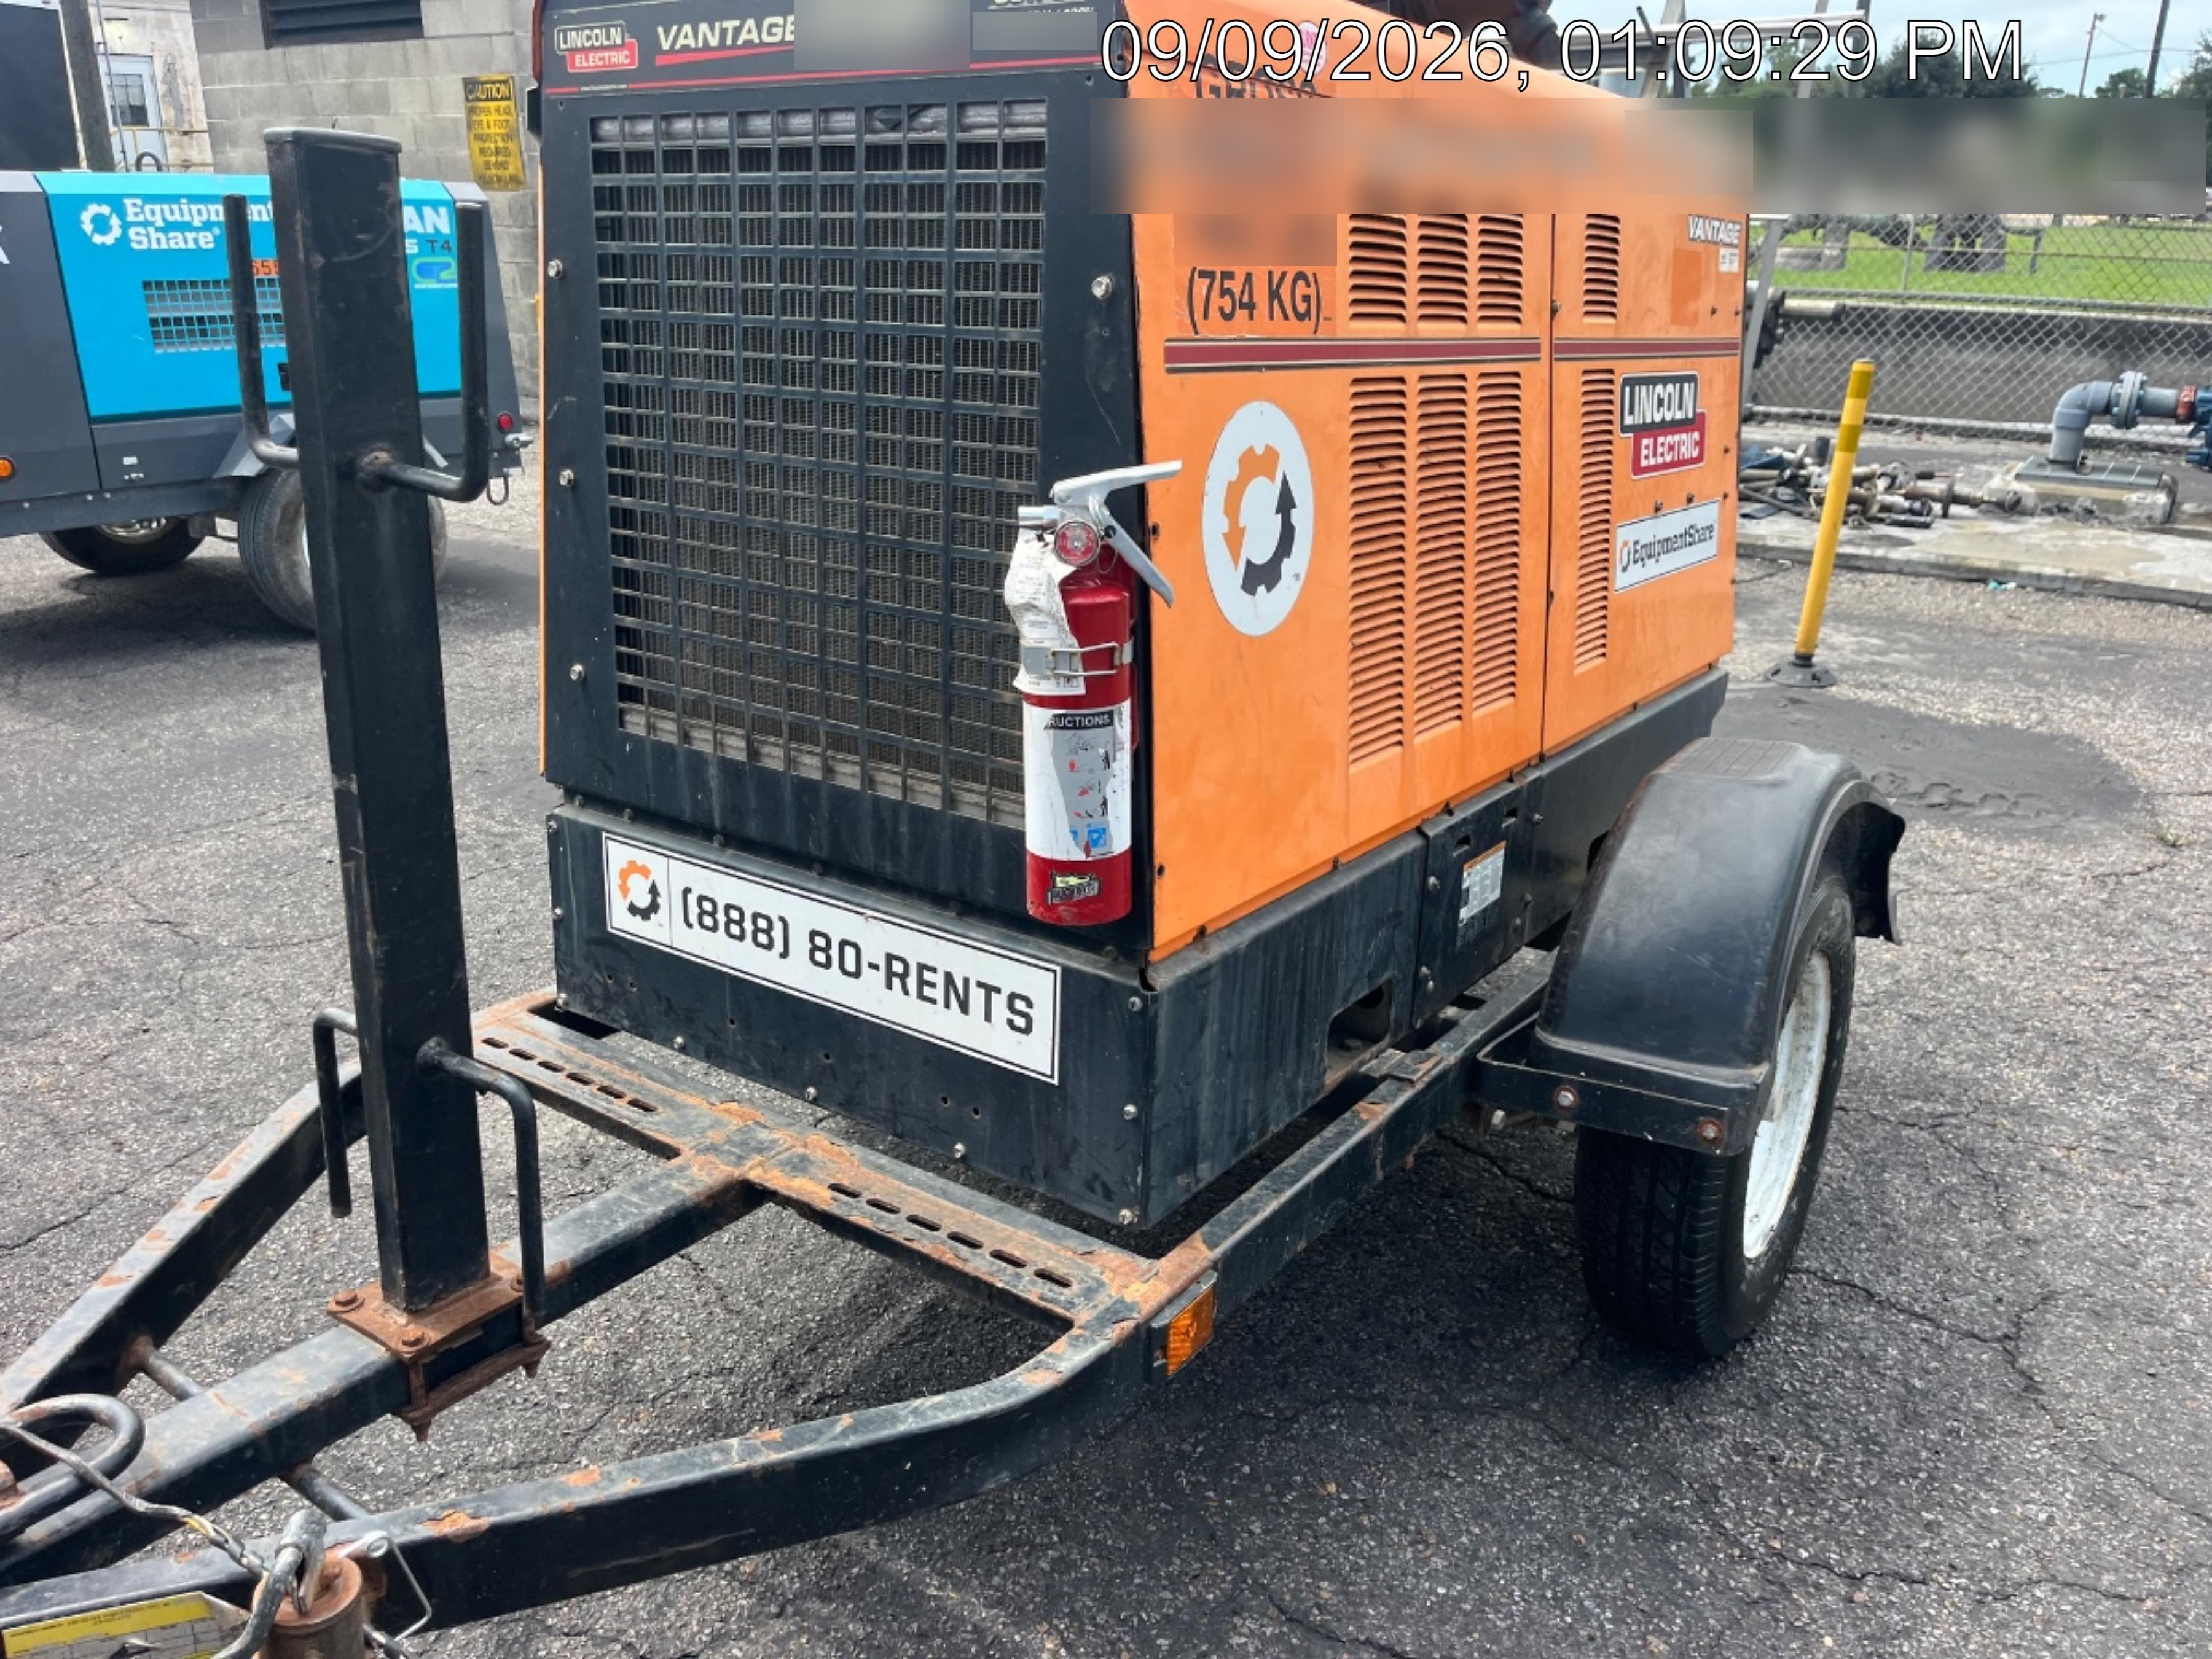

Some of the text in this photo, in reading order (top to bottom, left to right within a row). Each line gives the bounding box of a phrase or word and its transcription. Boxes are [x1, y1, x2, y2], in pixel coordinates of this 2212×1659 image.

[559, 26, 622, 50] LINCOLN
[574, 50, 630, 67] ELECTRIC
[466, 83, 510, 100] CAUTION
[1687, 214, 1741, 247] VANTAGE
[1186, 266, 1321, 335] (754 KG)
[1623, 381, 1695, 426] LINCOLN
[1639, 431, 1700, 467] ELECTRIC
[1631, 522, 1716, 568] EquipmentShare
[681, 885, 1035, 1037] (888) 80-RENTS
